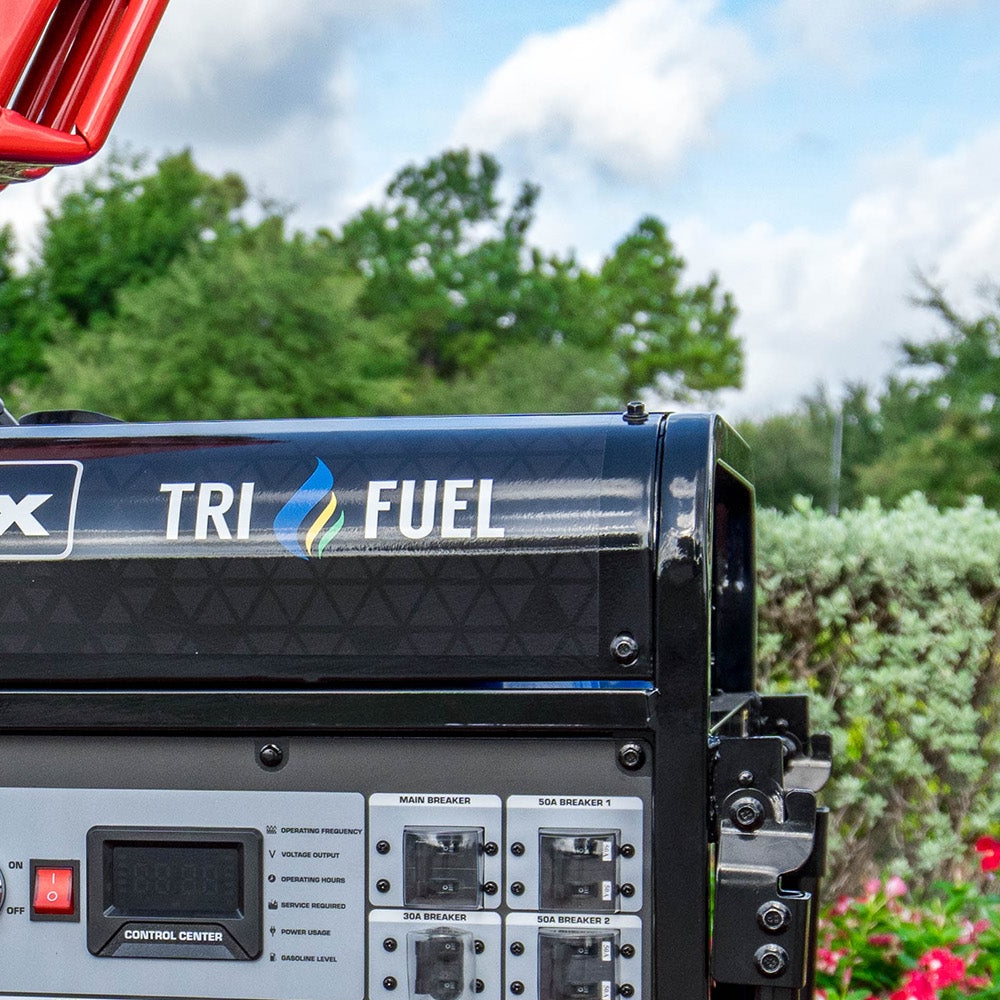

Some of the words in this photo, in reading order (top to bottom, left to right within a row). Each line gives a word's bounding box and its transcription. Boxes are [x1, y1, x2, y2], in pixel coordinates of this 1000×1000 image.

[159, 481, 255, 540] TRI
[364, 478, 505, 539] FUEL
[399, 796, 425, 804] MAIN
[427, 796, 471, 805] BREAKER
[538, 798, 558, 806] 50A
[559, 798, 604, 807] BREAKER
[605, 799, 611, 807] 1
[8, 861, 23, 869] ON
[6, 907, 25, 915] OFF
[403, 912, 422, 921] 30A
[423, 913, 467, 921] BREAKER
[537, 915, 556, 924] 50A
[558, 916, 603, 925] BREAKER
[604, 917, 611, 925] 2
[124, 929, 177, 941] CONTROL
[179, 931, 223, 942] CENTER
[280, 928, 307, 936] POWER
[280, 954, 315, 962] GASOLINE
